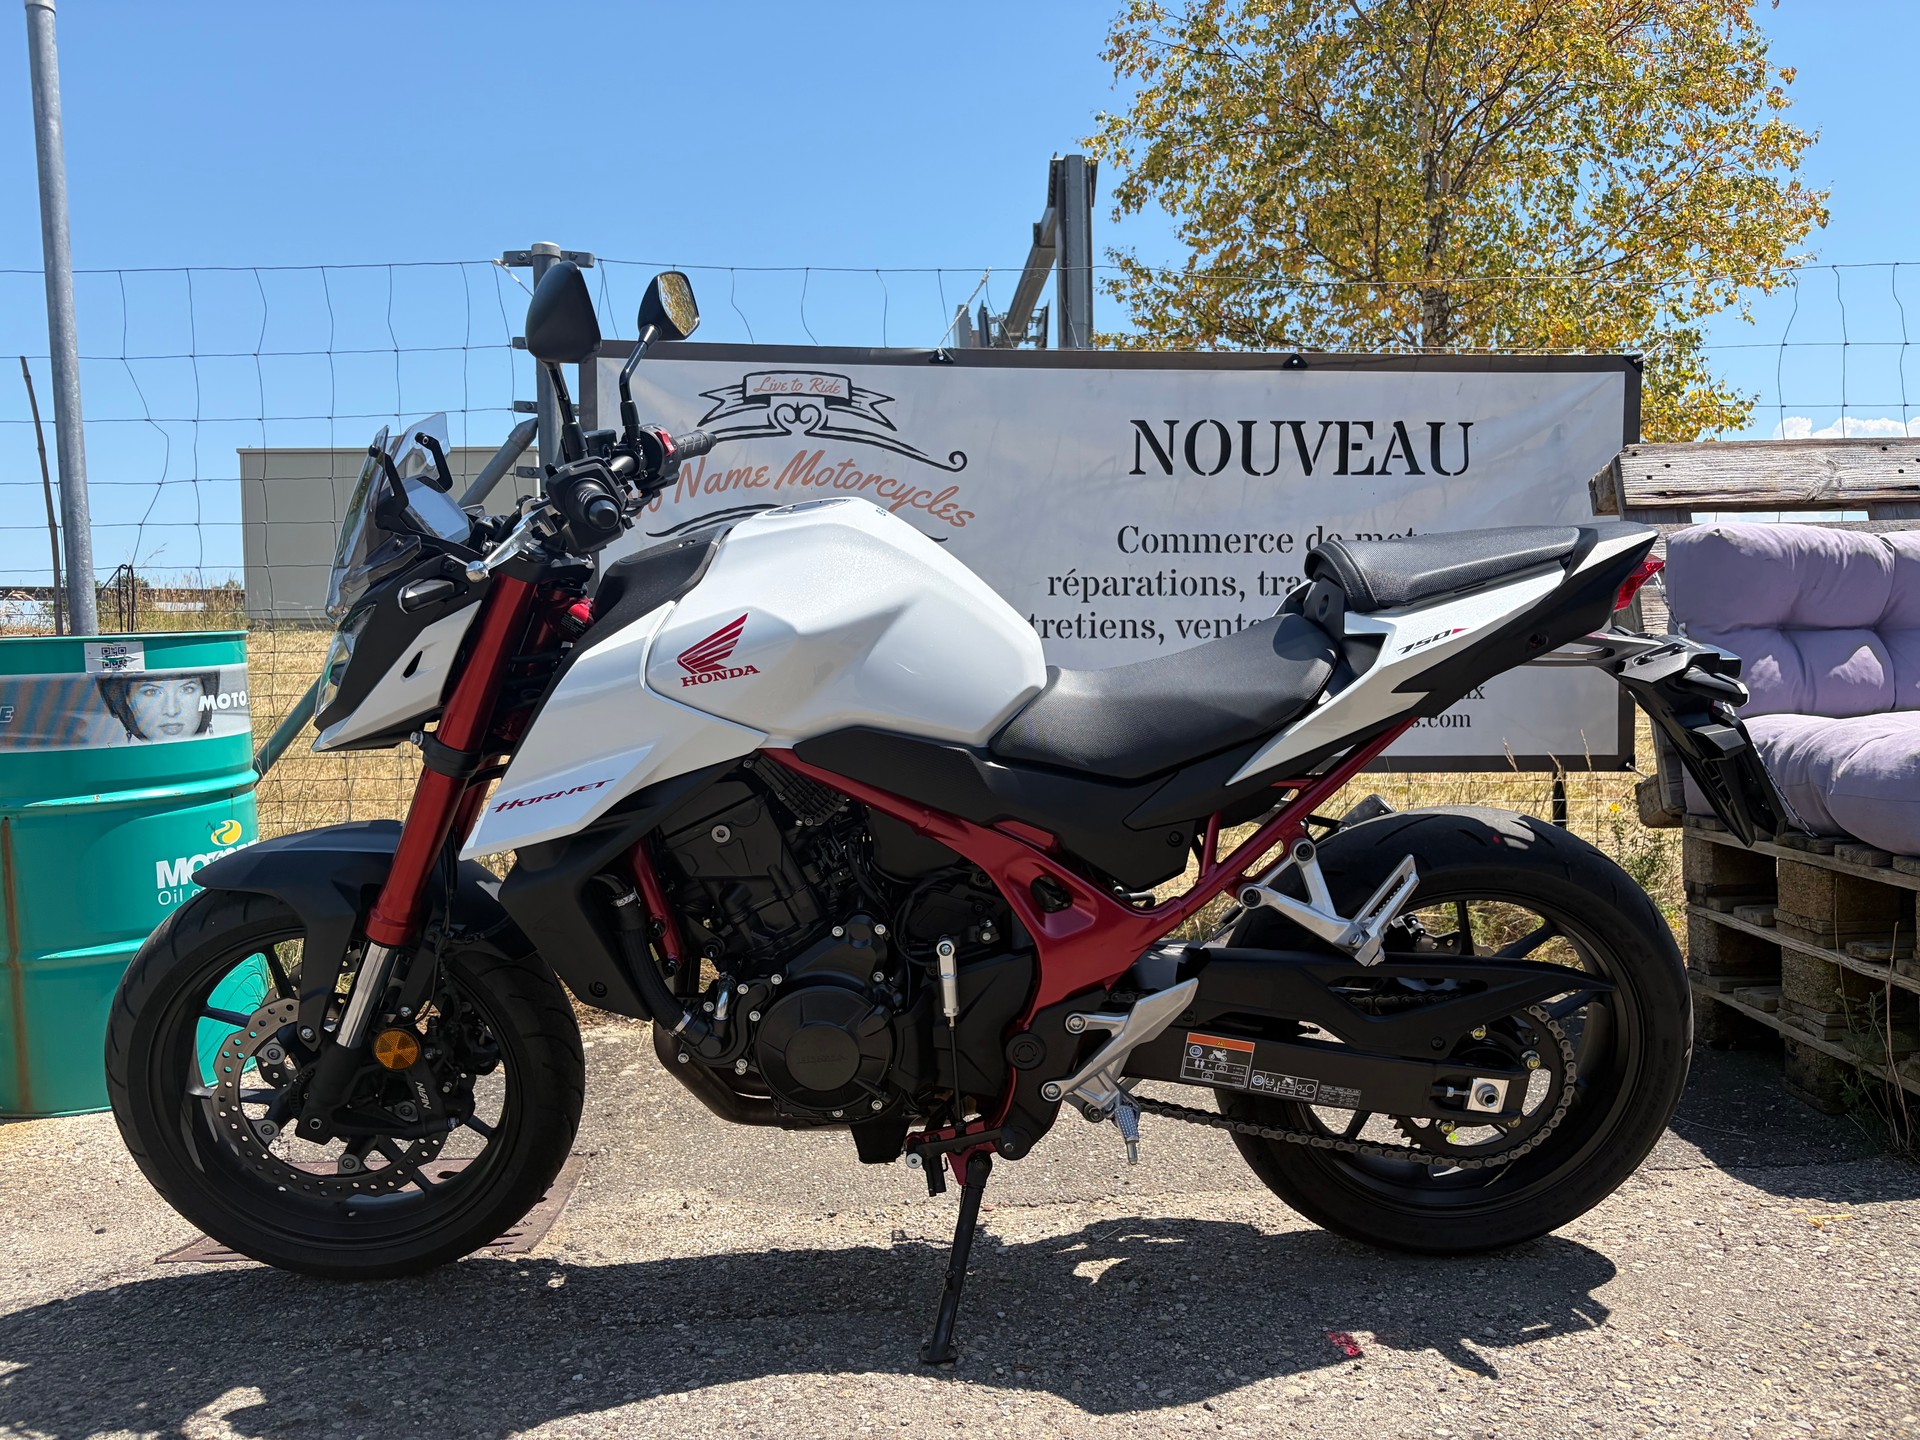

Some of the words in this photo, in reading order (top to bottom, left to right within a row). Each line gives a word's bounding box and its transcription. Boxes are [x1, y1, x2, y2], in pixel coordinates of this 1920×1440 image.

[753, 377, 789, 394] Live
[789, 376, 804, 392] to
[808, 377, 841, 395] Ride
[1129, 419, 1474, 477] NOUVEAU
[674, 456, 772, 505] Name
[773, 449, 975, 528] Motorcycles
[1117, 525, 1294, 554] Commerce
[1047, 569, 1246, 604] réparations,
[1398, 629, 1452, 655] 750
[681, 665, 761, 687] HONDA
[491, 778, 615, 813] HORNET
[158, 889, 184, 906] Oil
